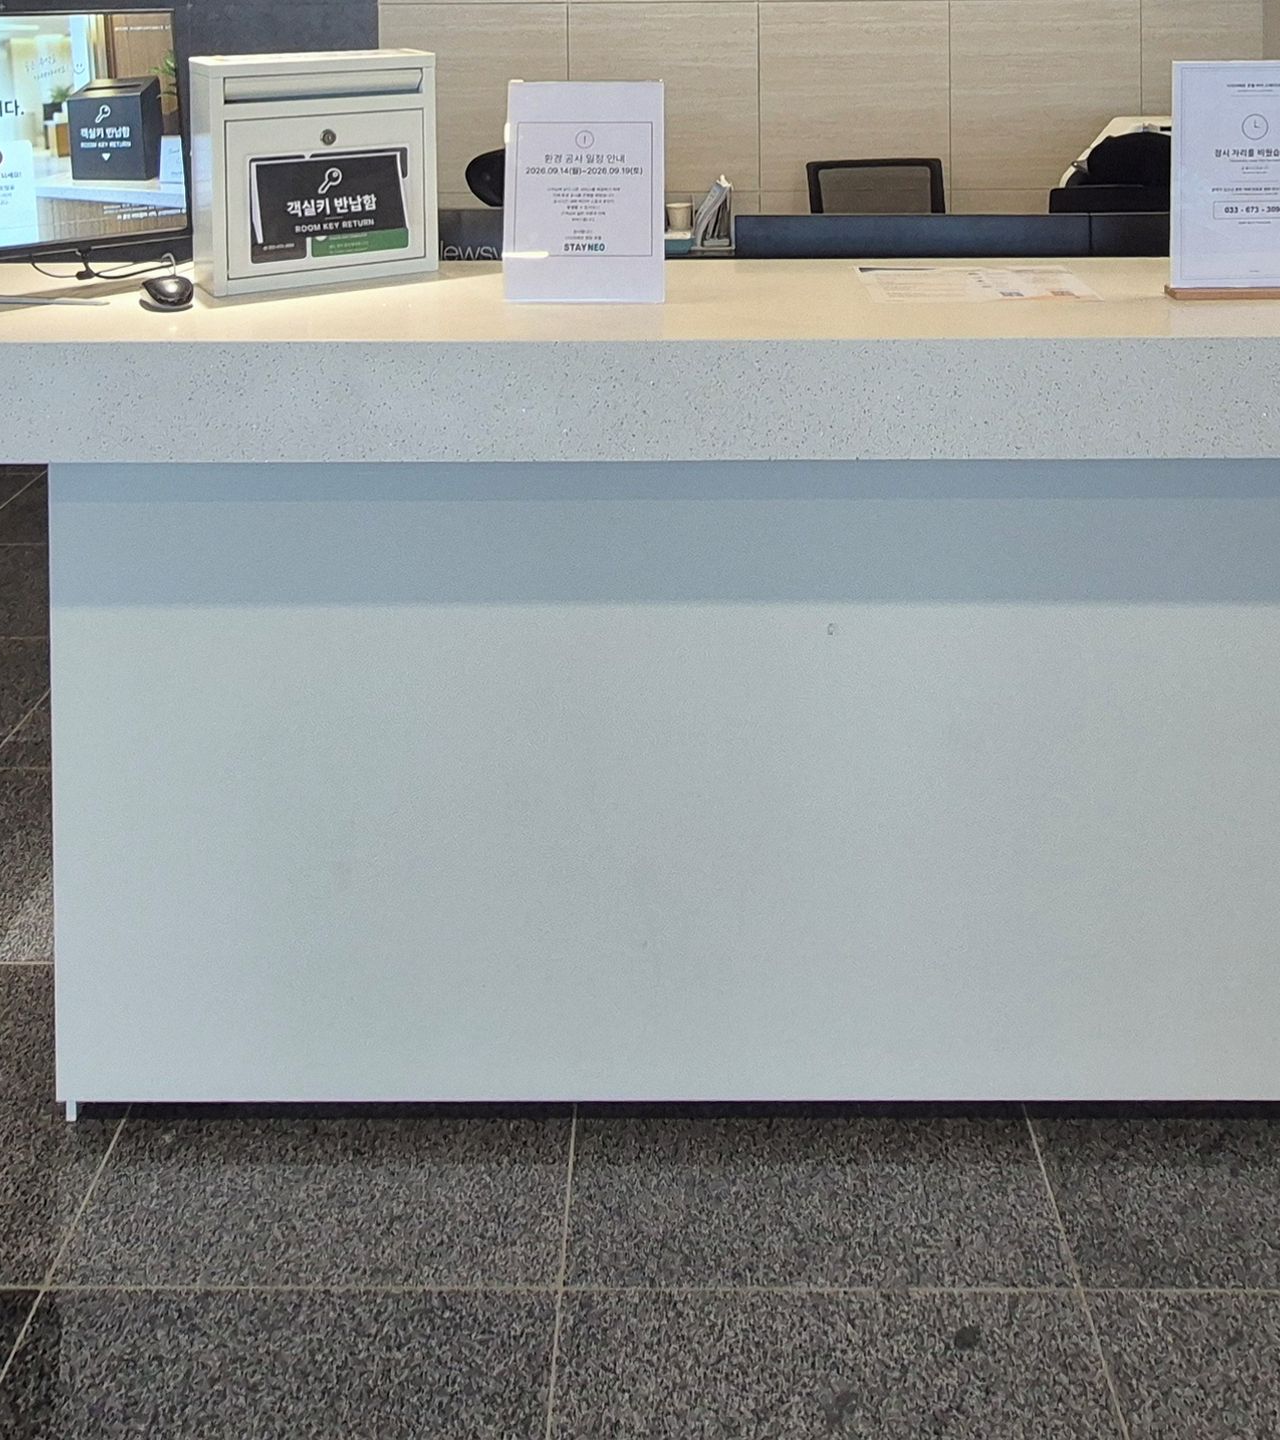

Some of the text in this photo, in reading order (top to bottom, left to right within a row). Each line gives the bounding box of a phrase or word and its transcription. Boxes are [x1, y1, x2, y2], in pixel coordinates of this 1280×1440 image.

[1214, 148, 1230, 158] 잠시
[1231, 148, 1255, 157] 자리를
[565, 154, 583, 164] 공사
[585, 154, 604, 164] 일정
[606, 154, 625, 164] 안내
[286, 194, 377, 218] 객실키 반납함
[1224, 206, 1239, 214] 033
[295, 218, 375, 234] ROOM KEY RETURN
